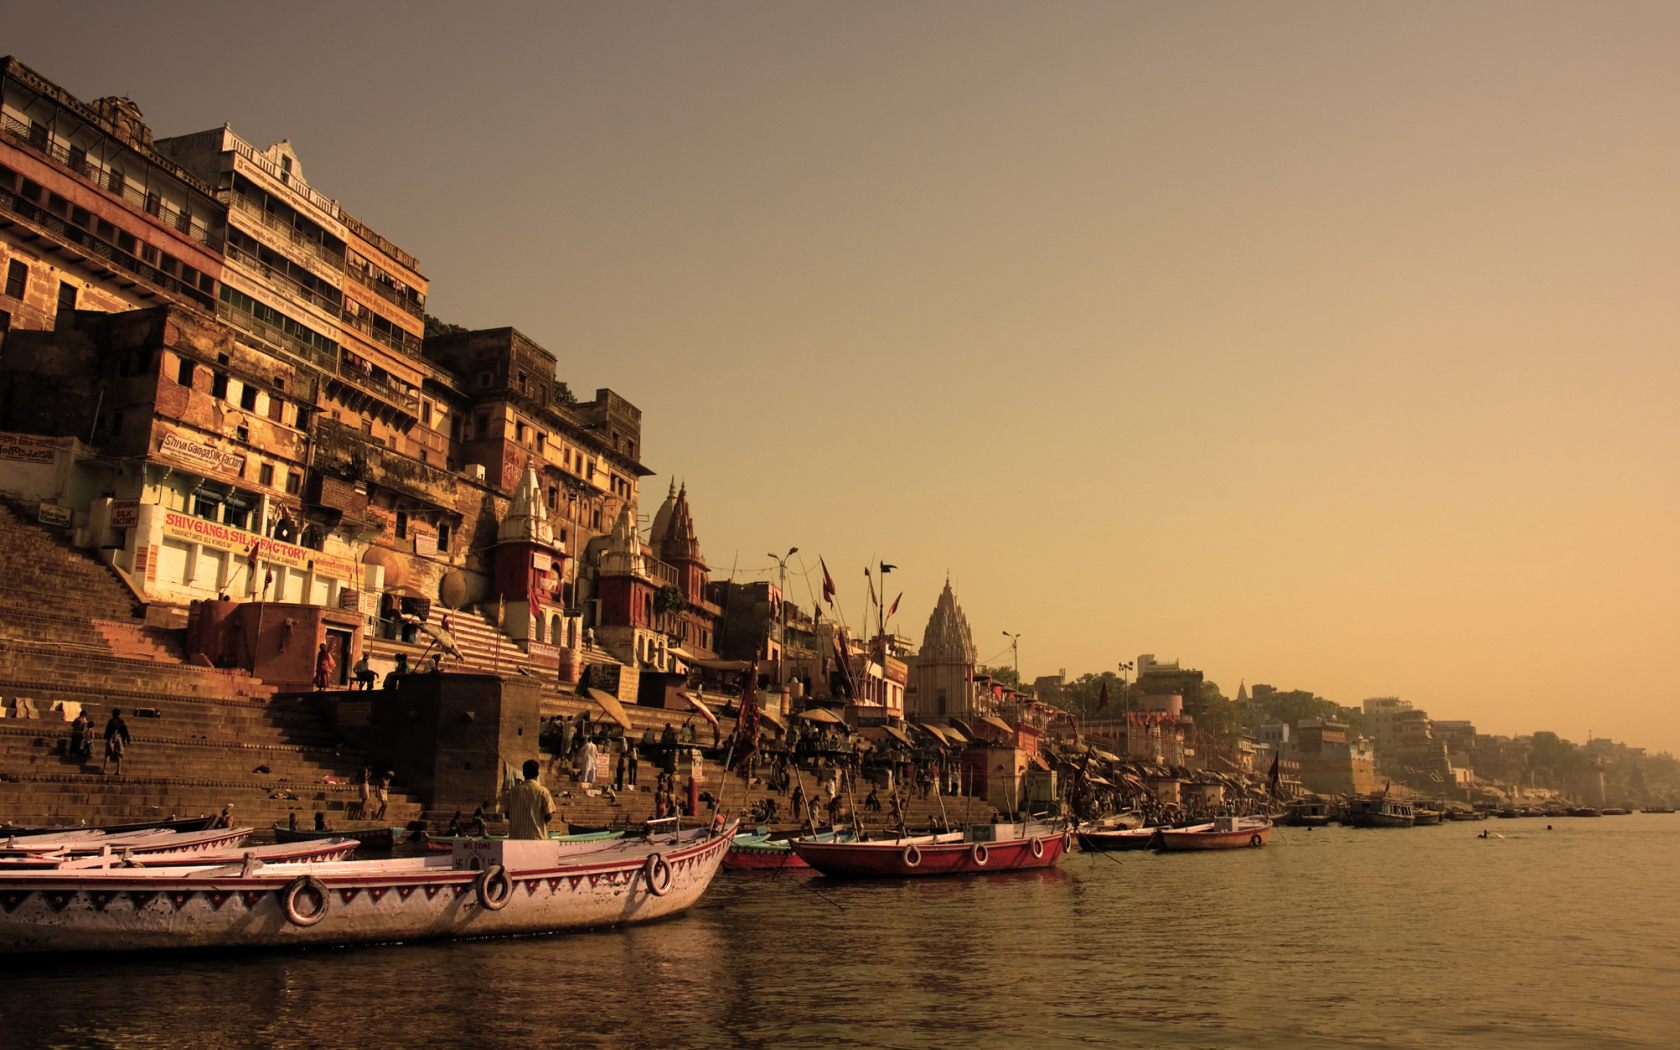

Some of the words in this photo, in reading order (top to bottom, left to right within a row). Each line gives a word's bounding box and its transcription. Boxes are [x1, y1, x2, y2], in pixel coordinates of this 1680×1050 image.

[113, 517, 136, 525] FACTORY
[166, 513, 229, 541] SHIVGANGA
[230, 531, 259, 547] SILK
[260, 538, 308, 561] FACTORY
